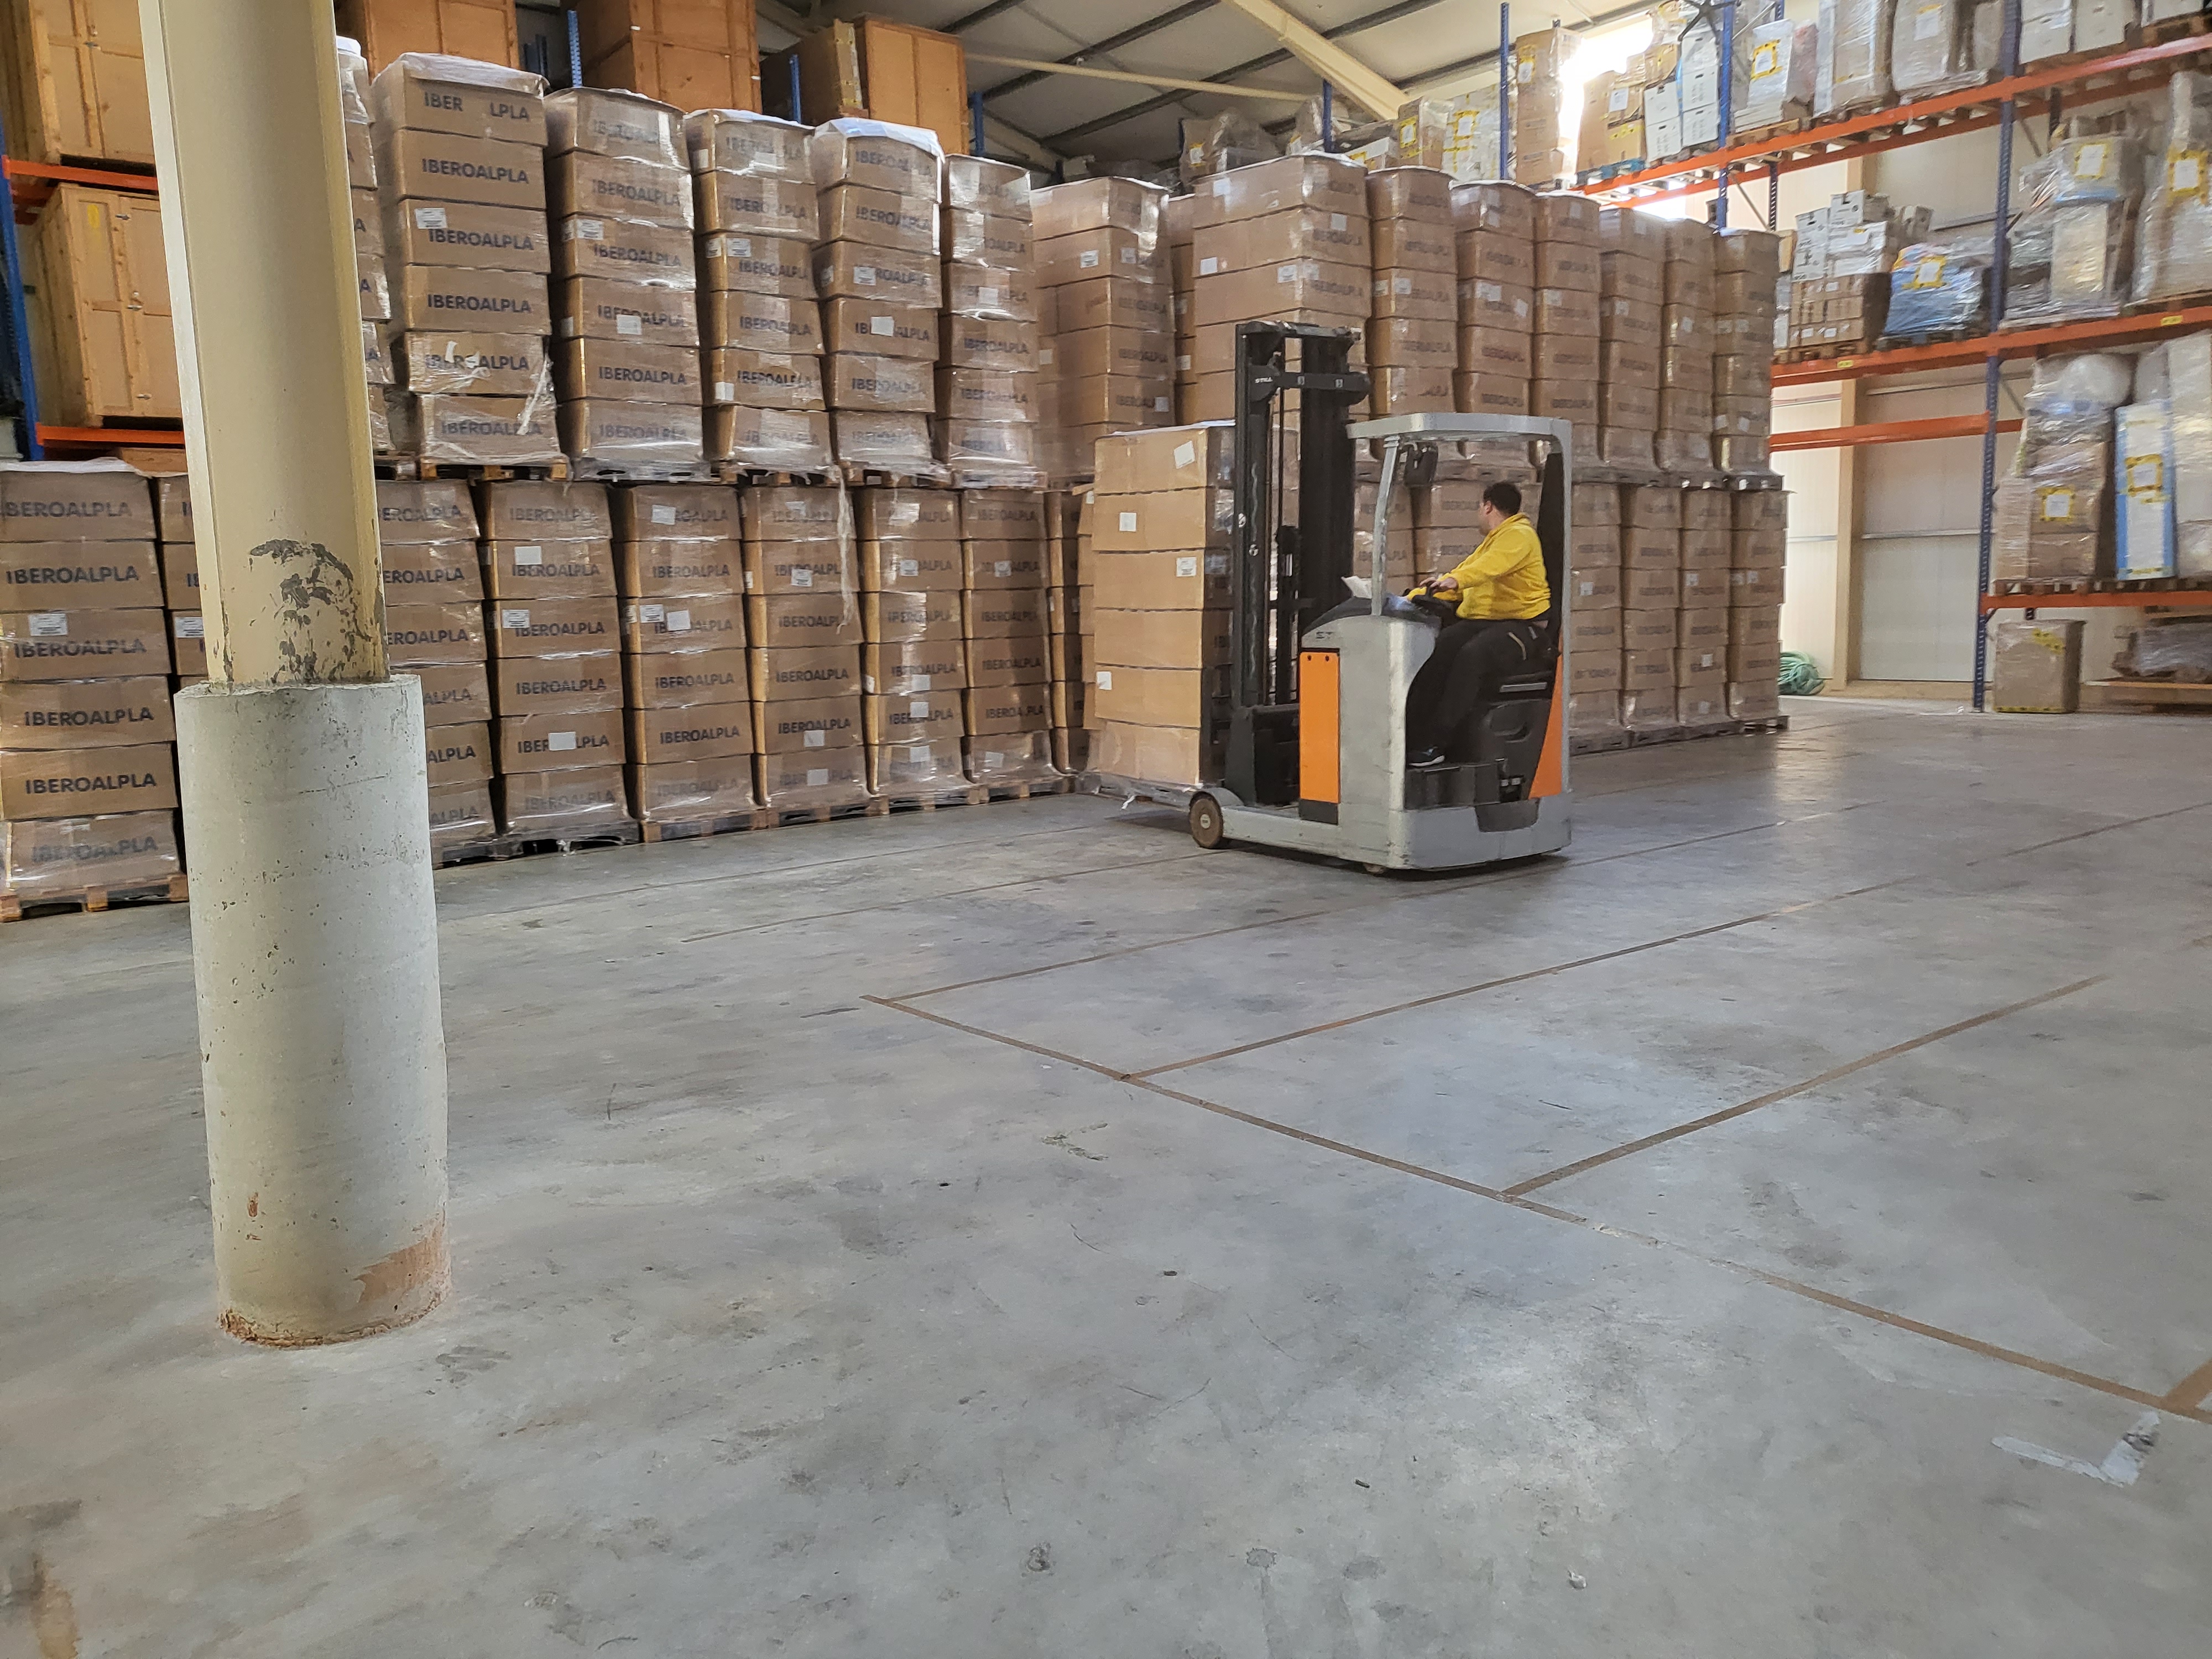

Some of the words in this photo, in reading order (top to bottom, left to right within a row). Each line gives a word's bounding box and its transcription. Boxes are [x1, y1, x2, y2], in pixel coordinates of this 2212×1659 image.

[422, 158, 529, 184] IBEROALPLA
[429, 228, 534, 251] IBEROALPLA
[427, 294, 531, 314] IBEROALPLA
[598, 366, 687, 385] IBEROALPLA
[6, 565, 139, 585] IBEROALPLA
[383, 567, 465, 583] EROALPLA
[387, 629, 469, 645] EROALPLA
[14, 638, 147, 658] IBEROALPLA
[776, 668, 849, 683] IBEROALPLA
[516, 677, 607, 695] IBEROALPLA
[24, 707, 154, 727] IBEROALPLA
[778, 718, 851, 734] IBEROALPLA
[518, 734, 610, 754] IBERLPLA
[660, 726, 740, 744] IBEROALPLA
[25, 773, 157, 795] IBEROALPLA
